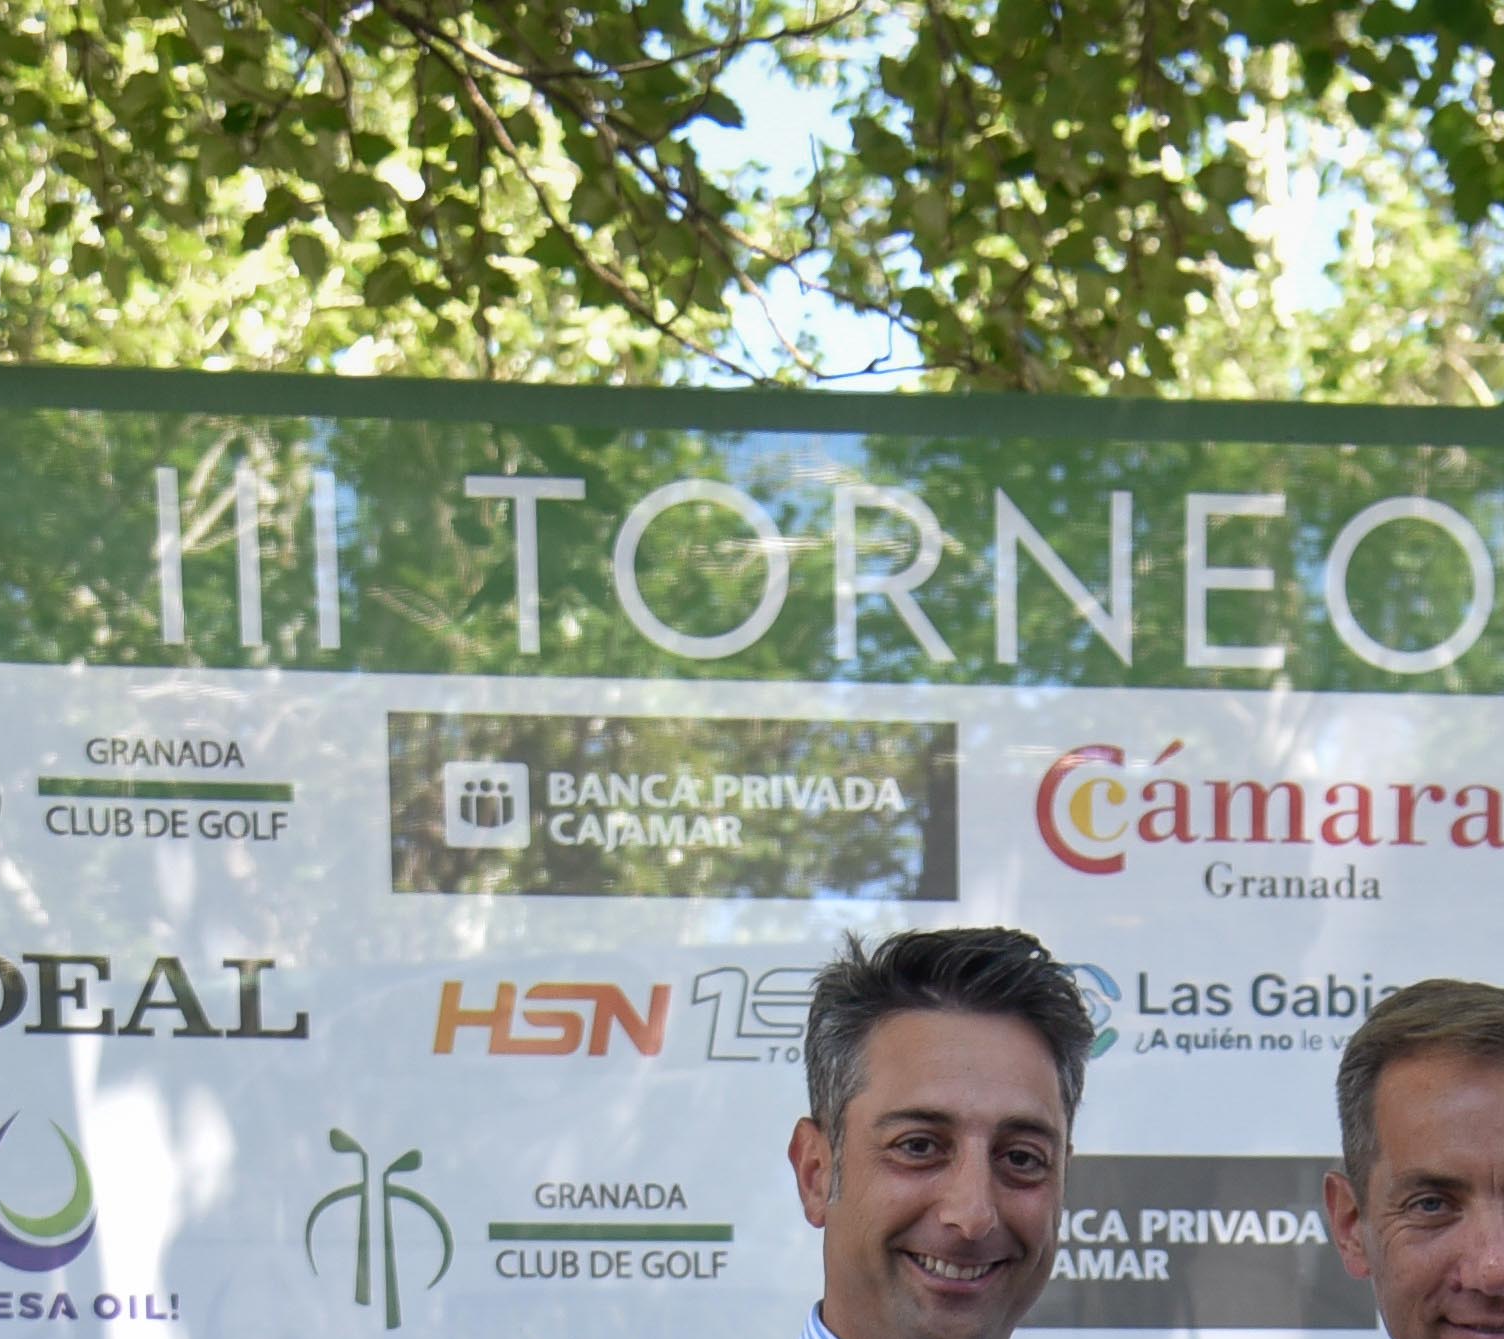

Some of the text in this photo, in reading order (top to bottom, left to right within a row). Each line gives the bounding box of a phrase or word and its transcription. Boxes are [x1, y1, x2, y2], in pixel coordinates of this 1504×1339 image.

[156, 467, 342, 650] III
[462, 474, 1495, 676] TORNEO
[85, 736, 246, 769] GRANADA
[549, 771, 906, 815] BANCA PRIVADA
[45, 805, 290, 842] CLUB DE GOLF
[548, 812, 742, 853] CAJAMAR
[1203, 861, 1383, 902] Granada
[1137, 970, 1401, 1019] Las Gabi
[433, 979, 672, 1059] HSN
[1134, 1027, 1324, 1055] ¿A quién no le
[534, 1181, 688, 1210] GRANADA
[1140, 1209, 1329, 1245] PRIVADA
[495, 1249, 729, 1279] CLUB DE GOLF
[1049, 1248, 1170, 1281] AMAR
[94, 1290, 180, 1321] OIL!
